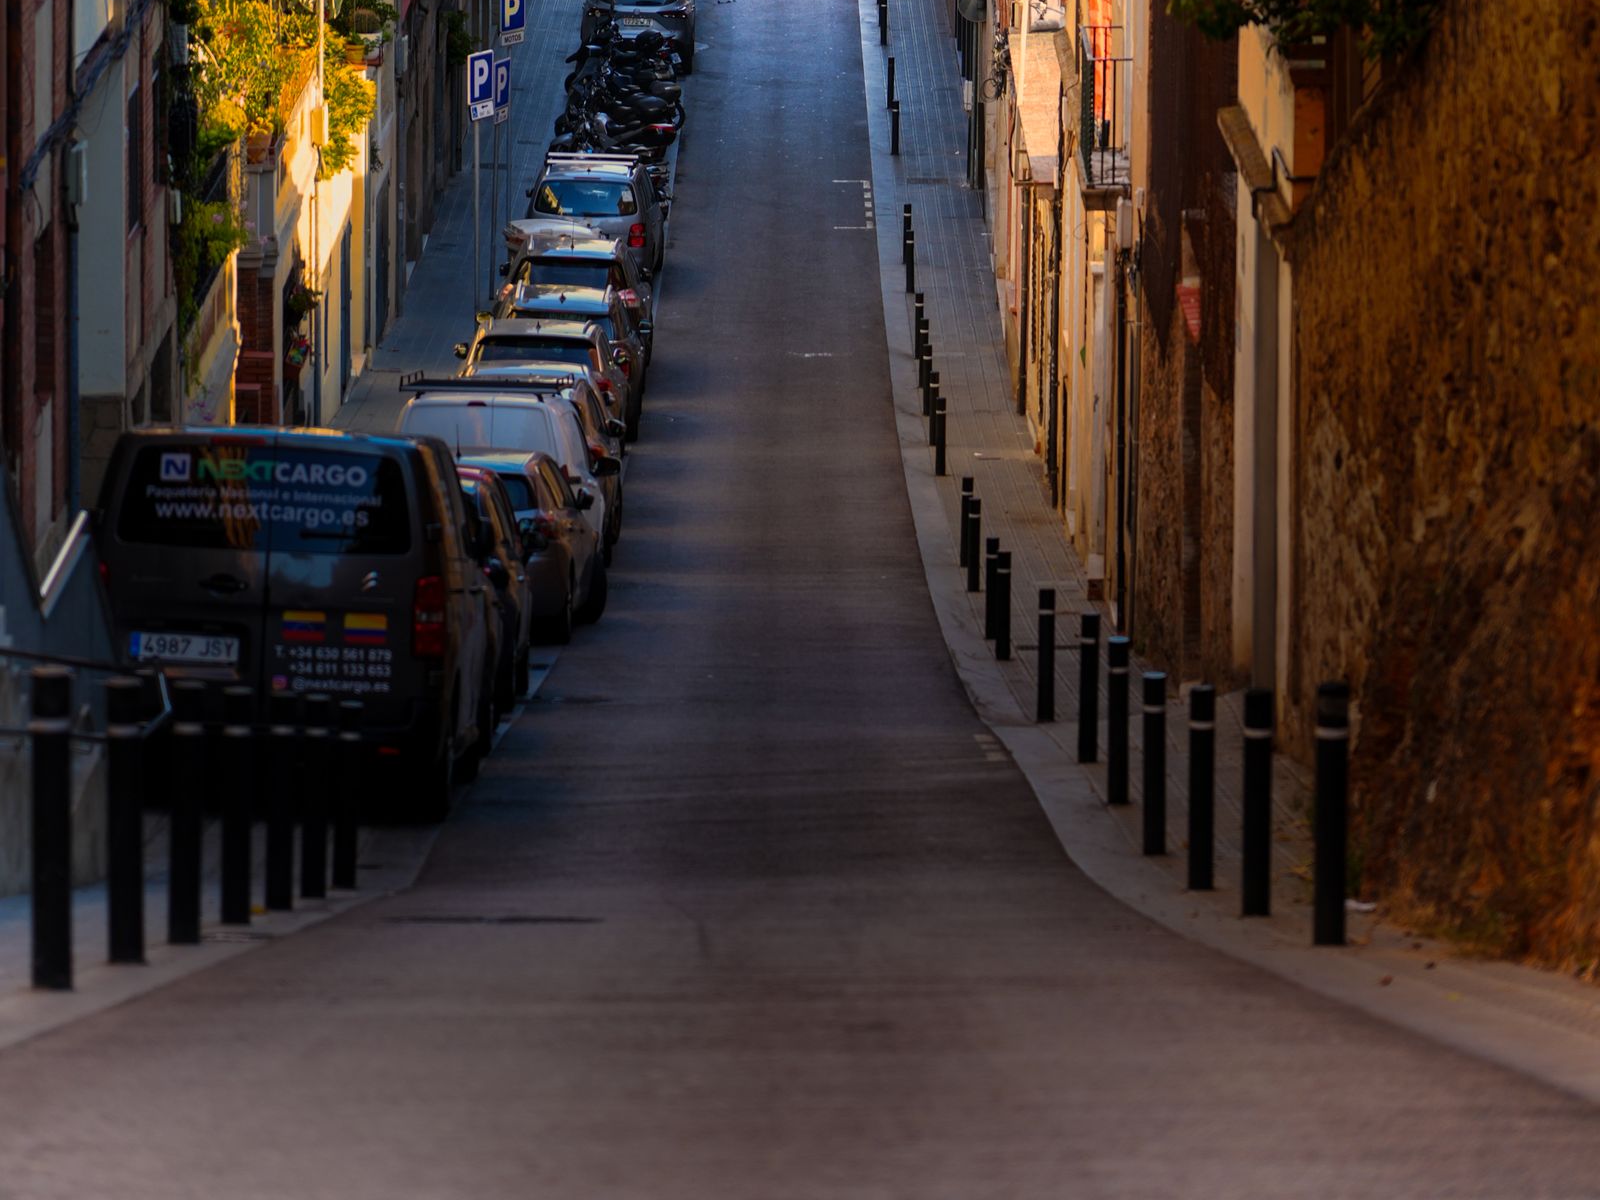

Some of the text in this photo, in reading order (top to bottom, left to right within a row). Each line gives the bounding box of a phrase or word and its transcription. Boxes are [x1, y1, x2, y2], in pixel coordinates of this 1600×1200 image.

[504, 33, 522, 44] MOTOS
[474, 59, 489, 98] P
[497, 66, 507, 103] P
[164, 457, 187, 478] N
[220, 486, 280, 500] Nacional
[293, 490, 382, 507] Internacional
[155, 501, 369, 528] www.nextcargo.es
[143, 636, 235, 658] 4987 JSY
[289, 646, 312, 659] +34
[289, 661, 312, 674] +34
[292, 675, 391, 693] @nextcargo.es
